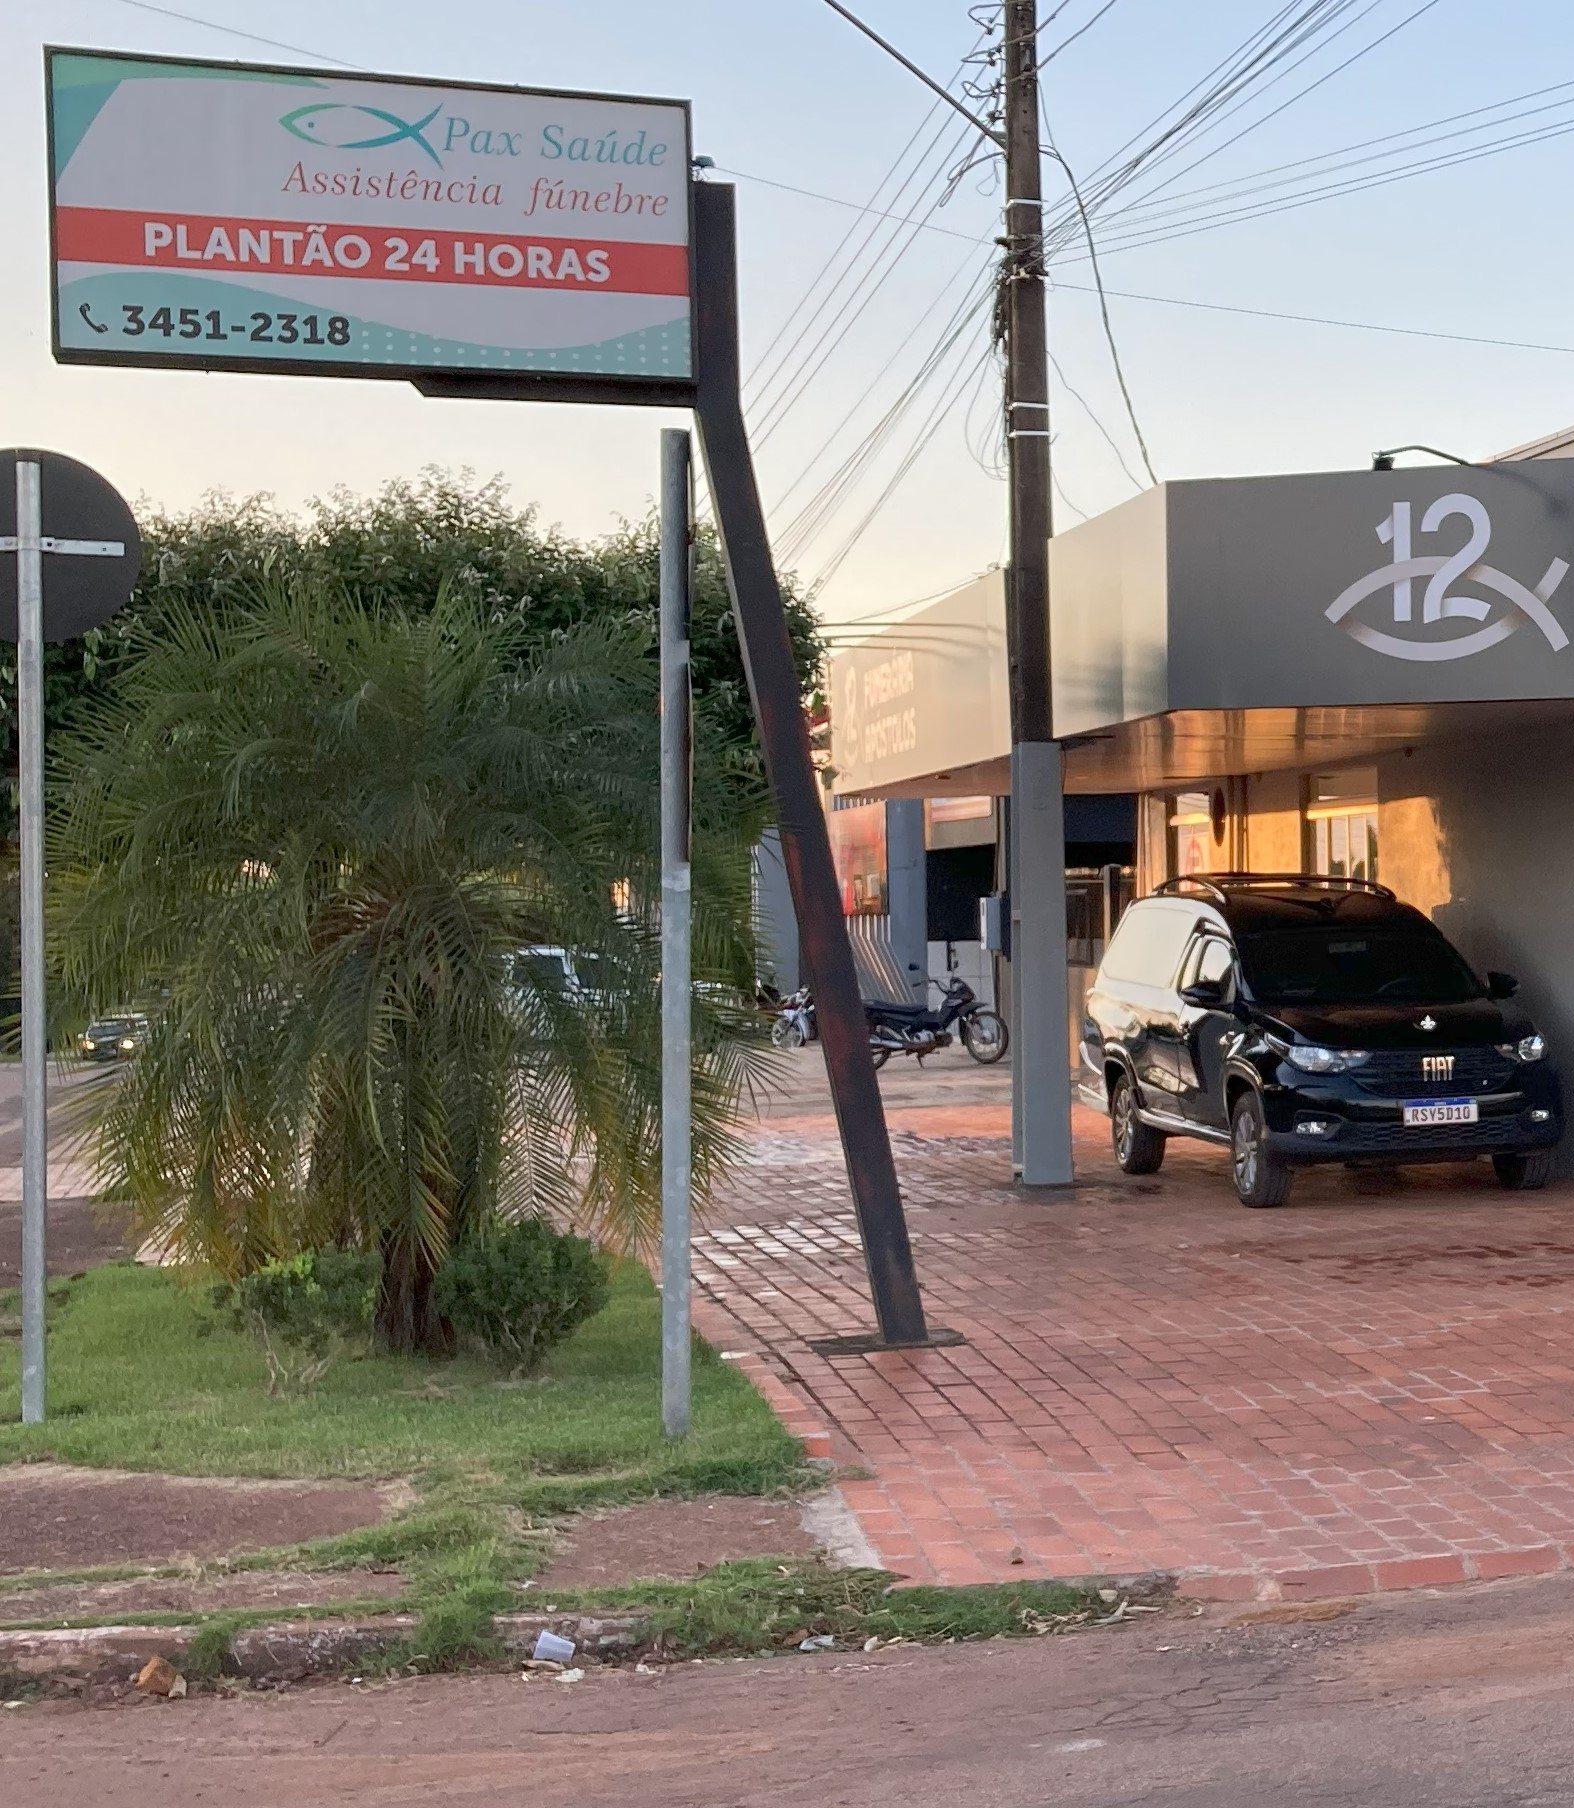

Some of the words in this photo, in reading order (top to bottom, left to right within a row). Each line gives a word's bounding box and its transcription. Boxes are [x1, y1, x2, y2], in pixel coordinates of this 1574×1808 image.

[442, 115, 523, 158] Pax
[539, 122, 669, 168] Saúde
[281, 161, 504, 208] Assistência
[523, 178, 670, 217] fúnebre
[144, 222, 370, 270] PLANTÃO
[383, 238, 441, 274] 24
[454, 243, 611, 283] HORAS
[121, 305, 352, 347] 3451-2318
[1375, 493, 1492, 624] 12
[1422, 1055, 1455, 1082] FIAT
[1411, 1106, 1471, 1123] RSY5D10
